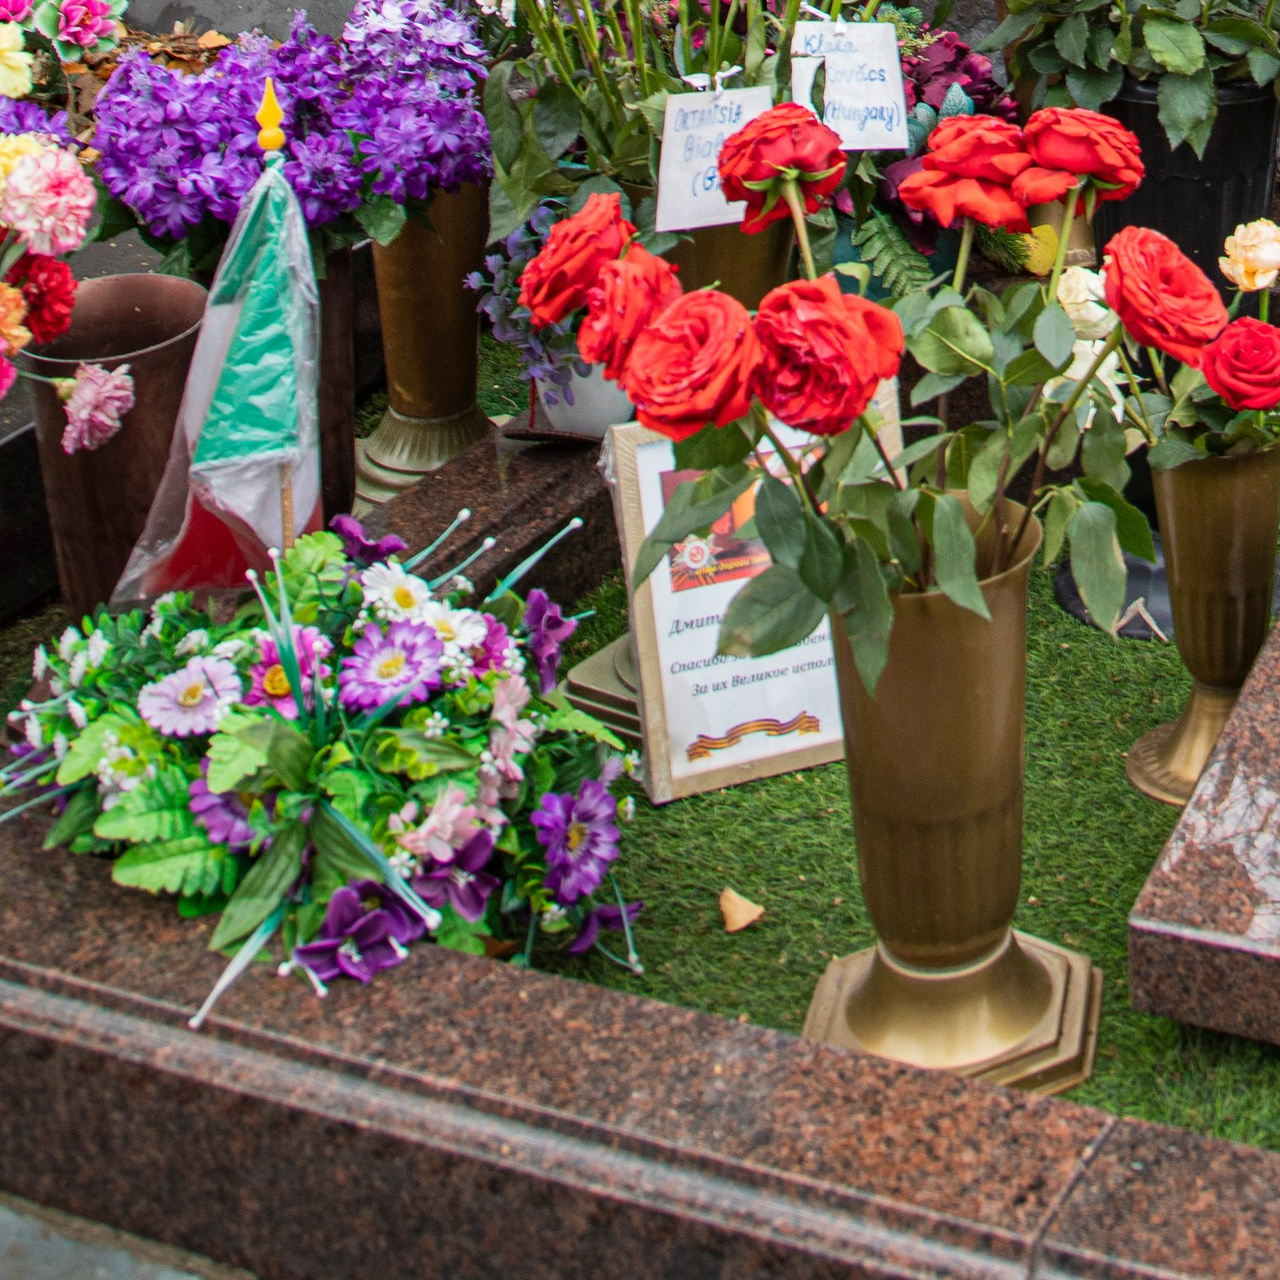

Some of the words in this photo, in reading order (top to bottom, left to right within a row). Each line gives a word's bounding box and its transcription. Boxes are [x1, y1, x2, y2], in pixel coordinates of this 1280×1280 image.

[668, 613, 724, 637] Дмит
[691, 682, 708, 697] За
[731, 666, 789, 688] Великое
